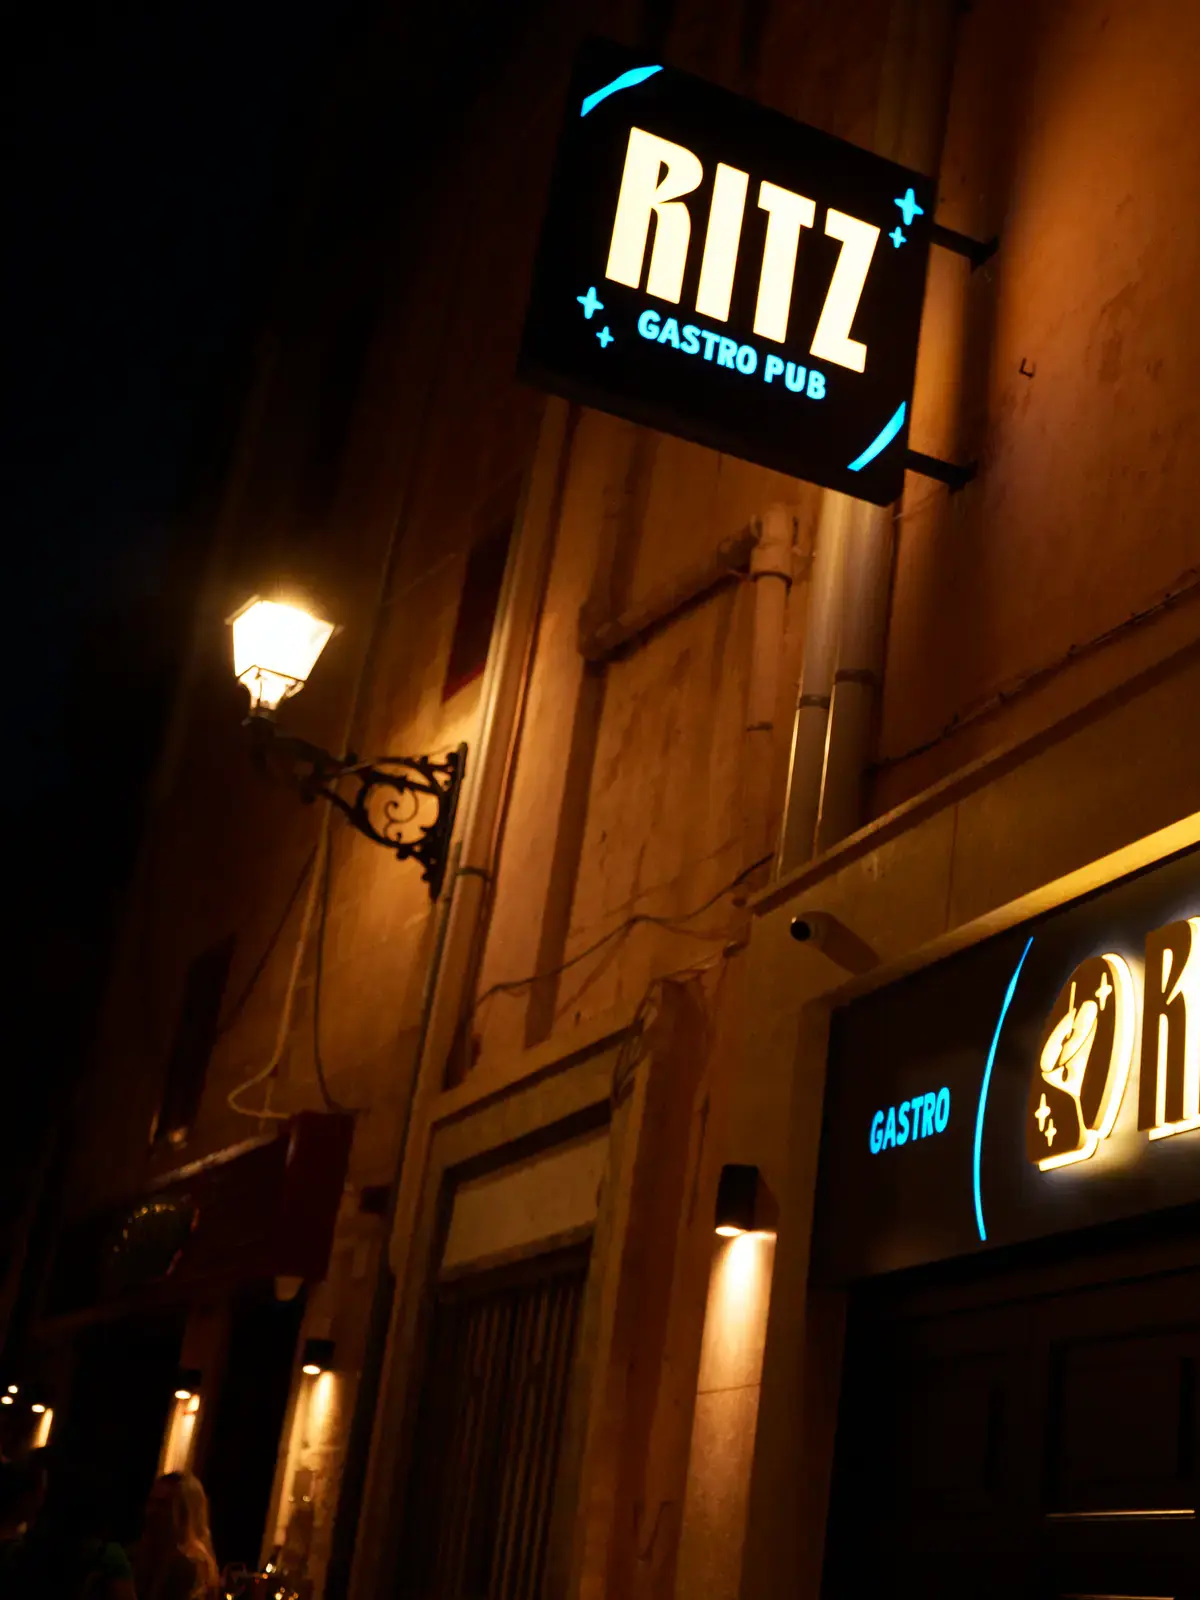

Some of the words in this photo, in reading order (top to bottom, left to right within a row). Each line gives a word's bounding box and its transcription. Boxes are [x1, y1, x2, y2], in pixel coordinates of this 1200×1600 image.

[604, 126, 881, 374] RITZ
[637, 309, 758, 375] GASTRO
[763, 354, 827, 400] PUB
[869, 1086, 950, 1154] GASTRO
